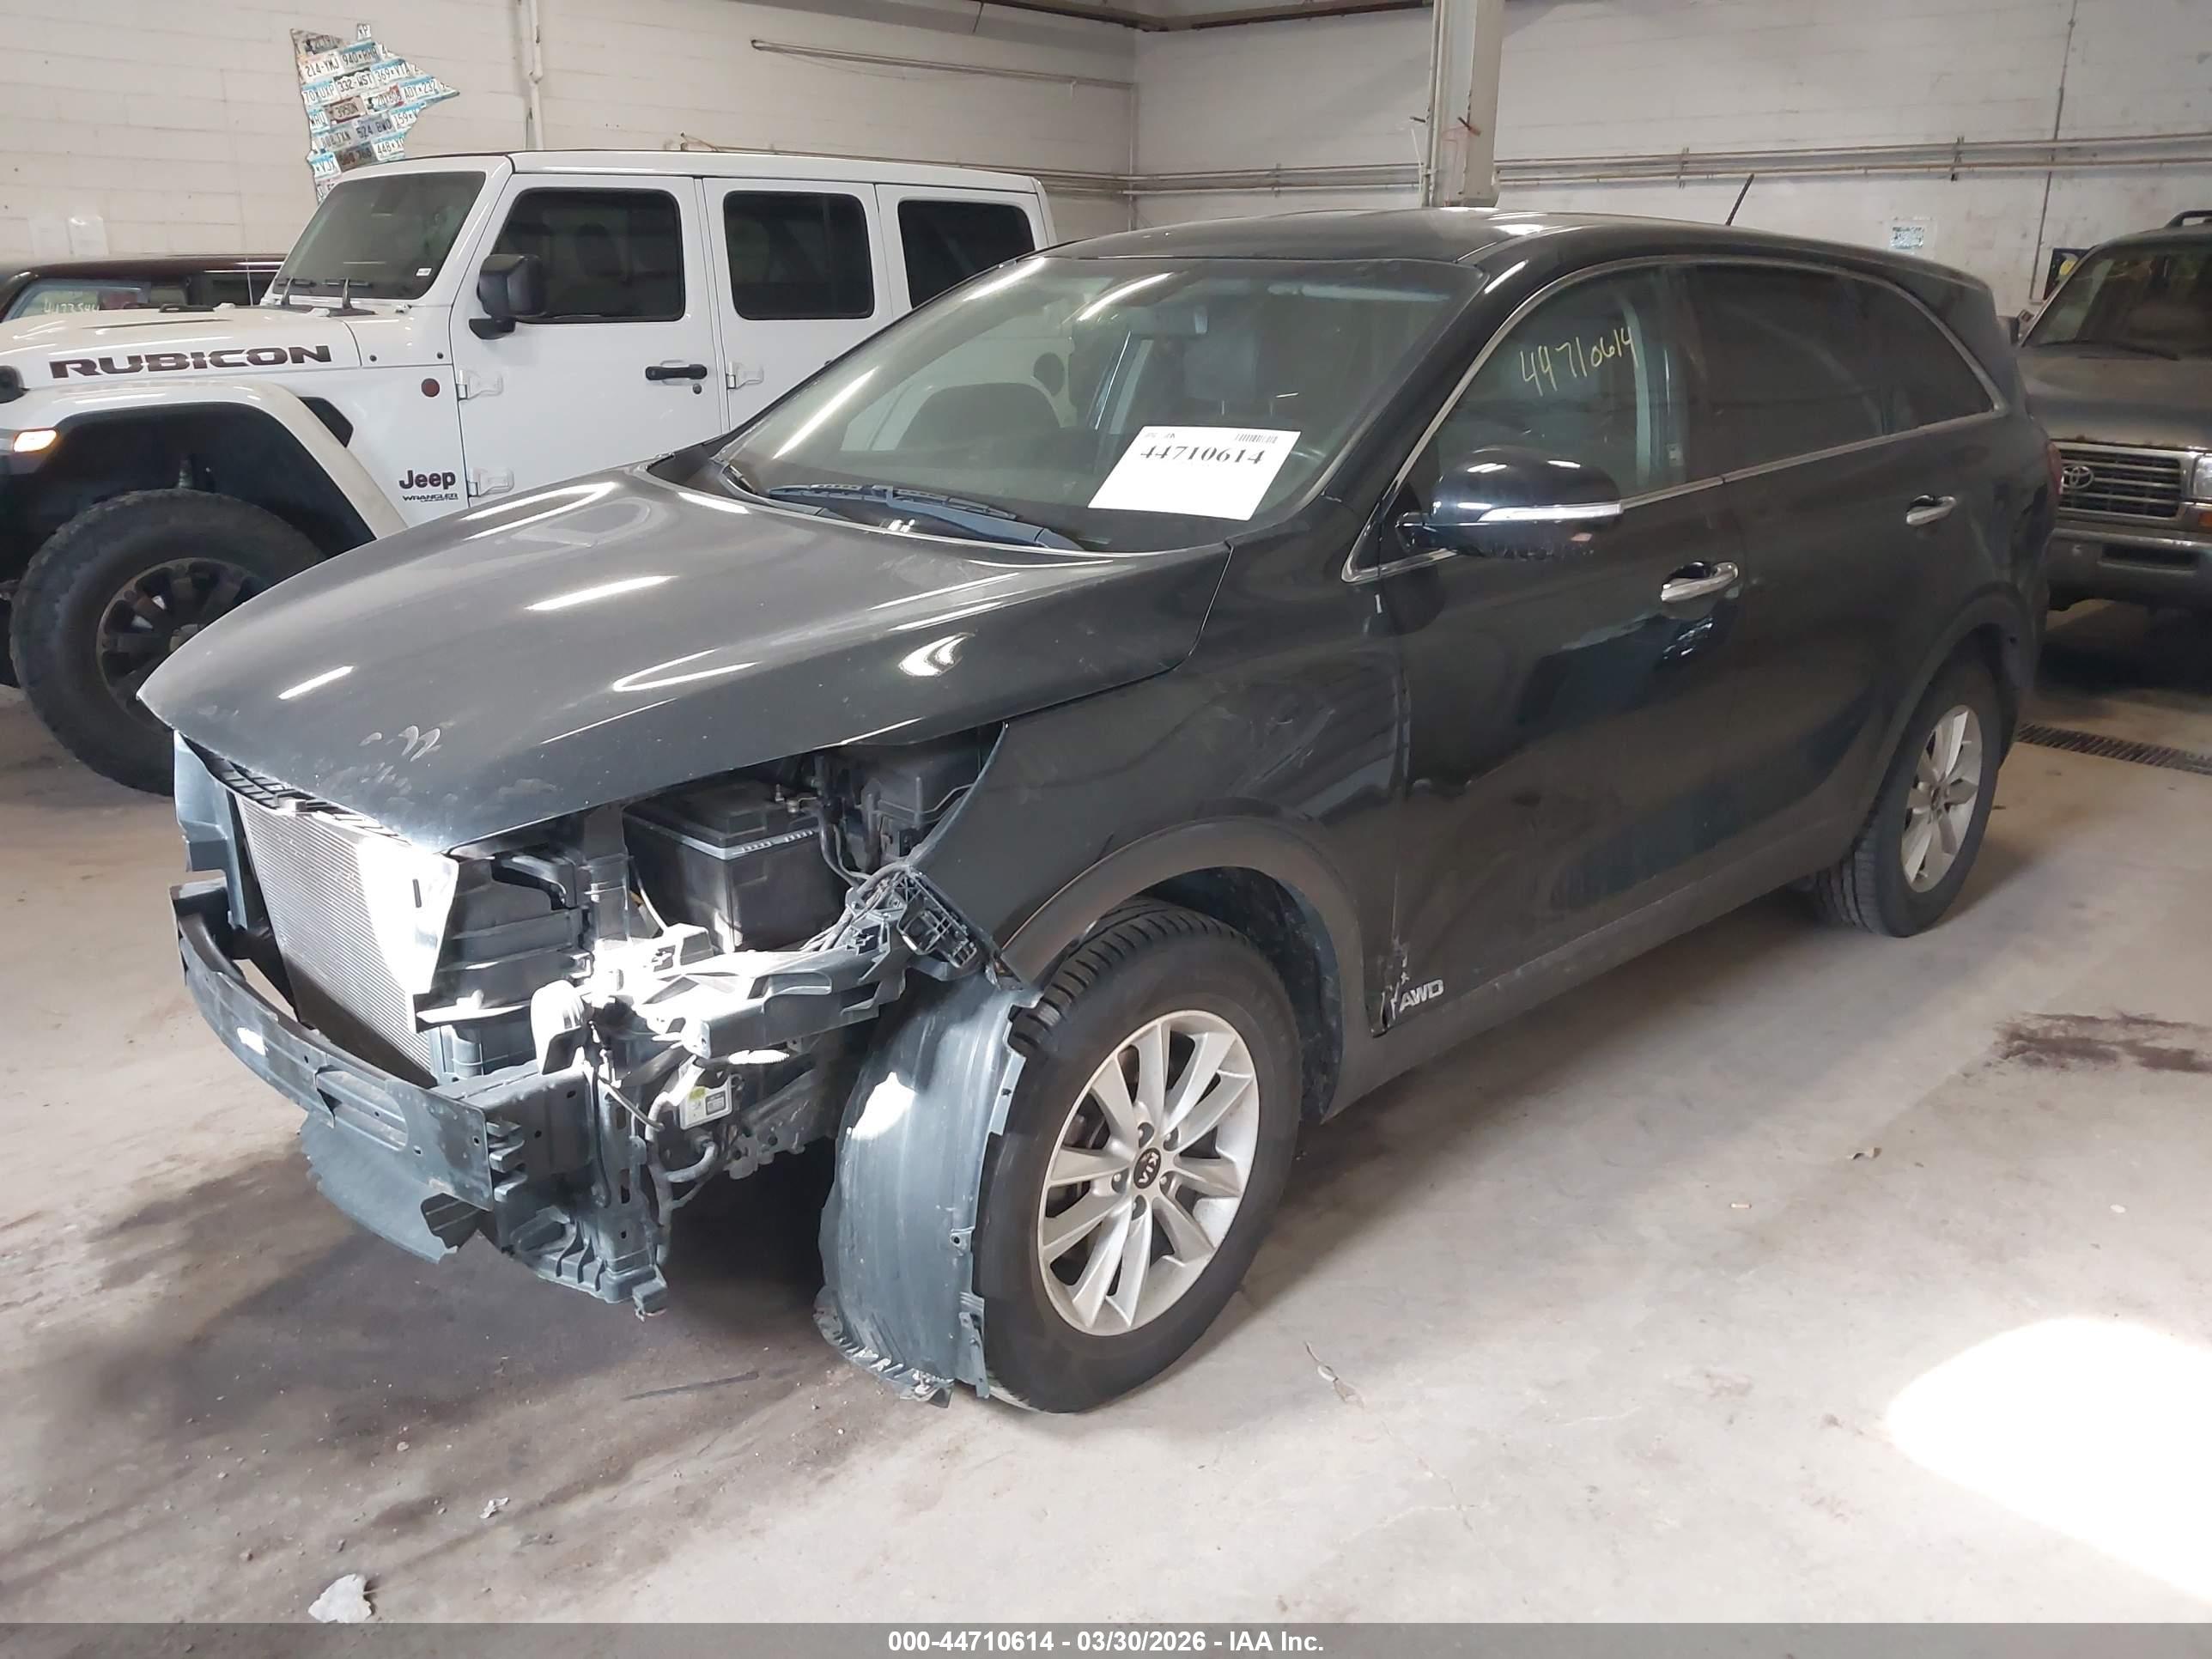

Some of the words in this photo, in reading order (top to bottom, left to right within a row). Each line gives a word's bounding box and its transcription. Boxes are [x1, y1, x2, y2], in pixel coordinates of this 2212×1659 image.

[49, 345, 331, 379] RUBICON
[1519, 325, 1639, 397] 44710614
[1139, 445, 1266, 465] 44710614
[399, 470, 456, 490] Jeep
[402, 493, 459, 501] WRANGLER
[1399, 979, 1444, 1012] AWD
